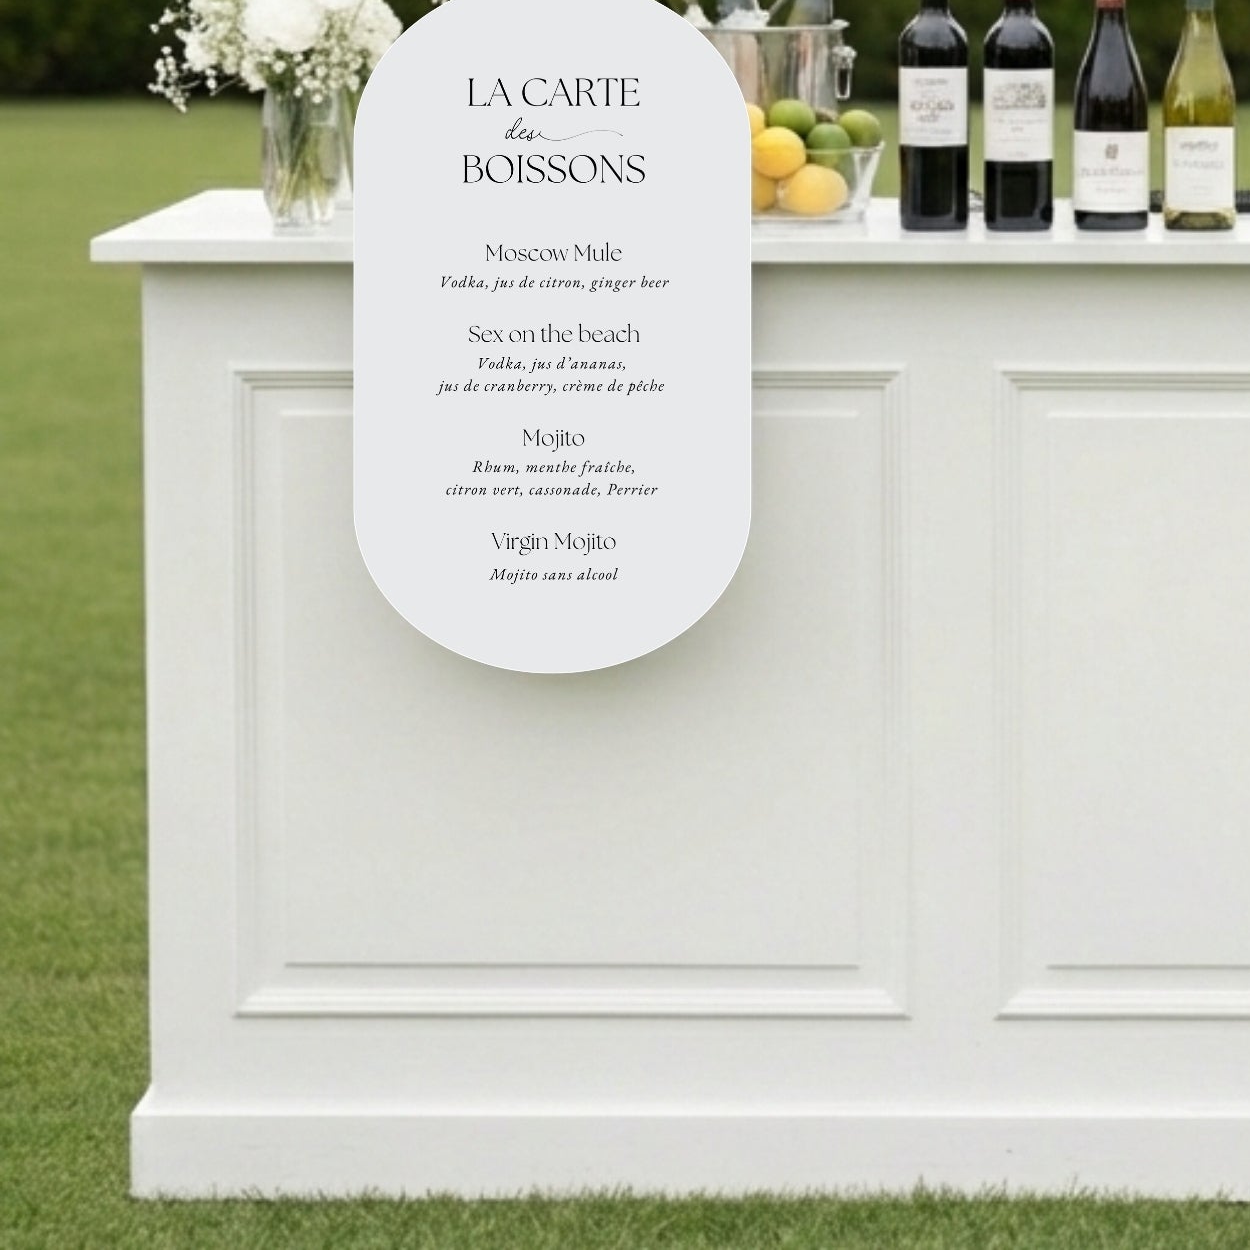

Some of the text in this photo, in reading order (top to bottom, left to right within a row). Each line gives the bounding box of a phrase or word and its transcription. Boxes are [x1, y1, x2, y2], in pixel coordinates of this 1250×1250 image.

[467, 78, 641, 106] LA CARTE
[462, 155, 646, 183] BOISSONS
[485, 242, 623, 261] Moscow Mule
[441, 275, 670, 293] Vodka, jus de citron, ginger beer
[468, 323, 640, 342] Sex on the beach
[478, 357, 626, 373] Vodka, jus d’ananas,
[435, 379, 665, 397] jus de cranberry, crème de pêche
[522, 429, 585, 452] Mojito
[471, 460, 635, 477] Rhum, menthe fraîche,
[445, 483, 659, 497] citron vert, cassonade, Perrier
[491, 533, 617, 556] Virgin Mojito
[488, 568, 619, 584] Mojito sans alcool
